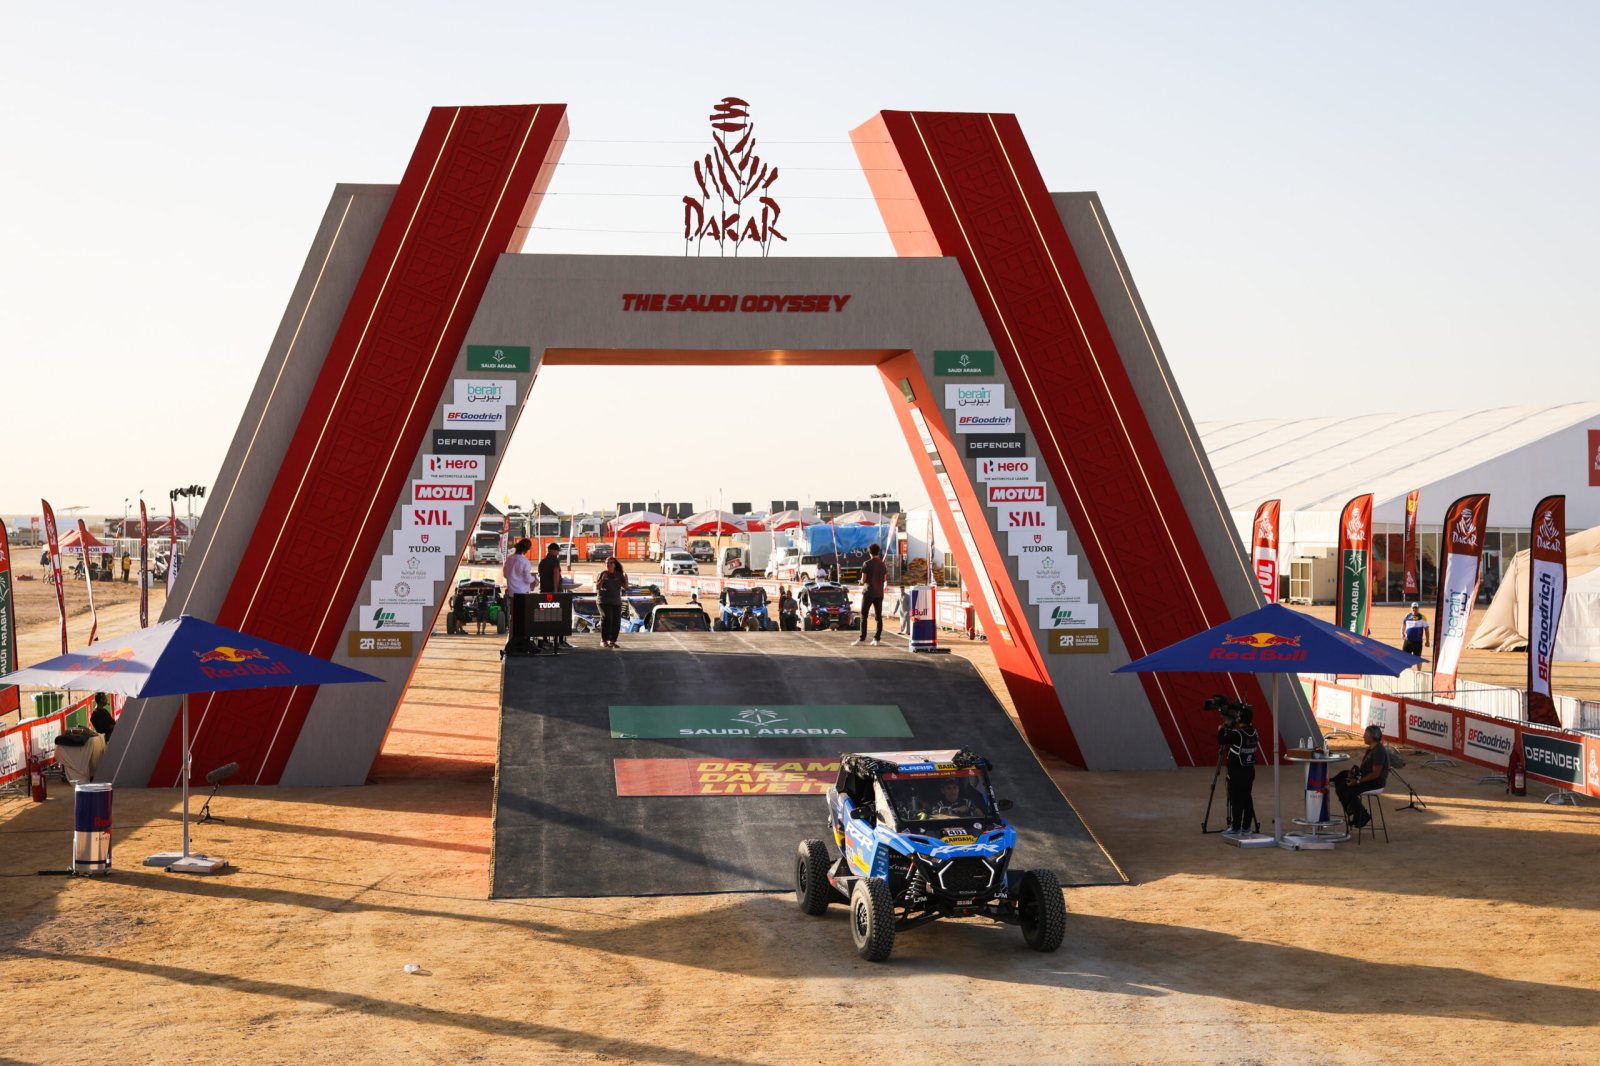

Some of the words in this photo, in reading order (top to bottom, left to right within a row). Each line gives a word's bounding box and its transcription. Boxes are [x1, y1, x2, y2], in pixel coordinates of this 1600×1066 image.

[683, 195, 787, 242] DAKAR
[622, 293, 664, 312] THE
[667, 294, 738, 313] SAUDI
[740, 294, 852, 313] ODYSSEY
[467, 383, 501, 395] berain
[958, 387, 991, 399] berain
[447, 412, 503, 421] BFGoodrich
[959, 416, 1012, 424] BFGoodrich
[437, 438, 491, 446] DEFENDER
[417, 484, 470, 499] MOTUL
[992, 488, 1042, 500] MOTUL
[1452, 531, 1478, 546] DAKAR
[1537, 535, 1562, 553] DAKAR
[408, 545, 441, 553] TUDOR
[1022, 545, 1053, 553] TUDOR
[1350, 580, 1360, 618] ARABIA
[1538, 572, 1552, 682] BFGoodrich
[1209, 647, 1258, 661] Red
[1258, 649, 1308, 662] Bull
[200, 664, 249, 678] Red
[246, 661, 293, 675] Bull
[1408, 714, 1449, 734] BFGoodrich
[680, 728, 750, 736] SAUDI
[757, 728, 848, 736] ARABIA
[1468, 728, 1511, 750] BFGoodrich
[1524, 745, 1581, 772] DEFENDER
[698, 772, 818, 783] DARE.
[700, 782, 787, 794] LIVE
